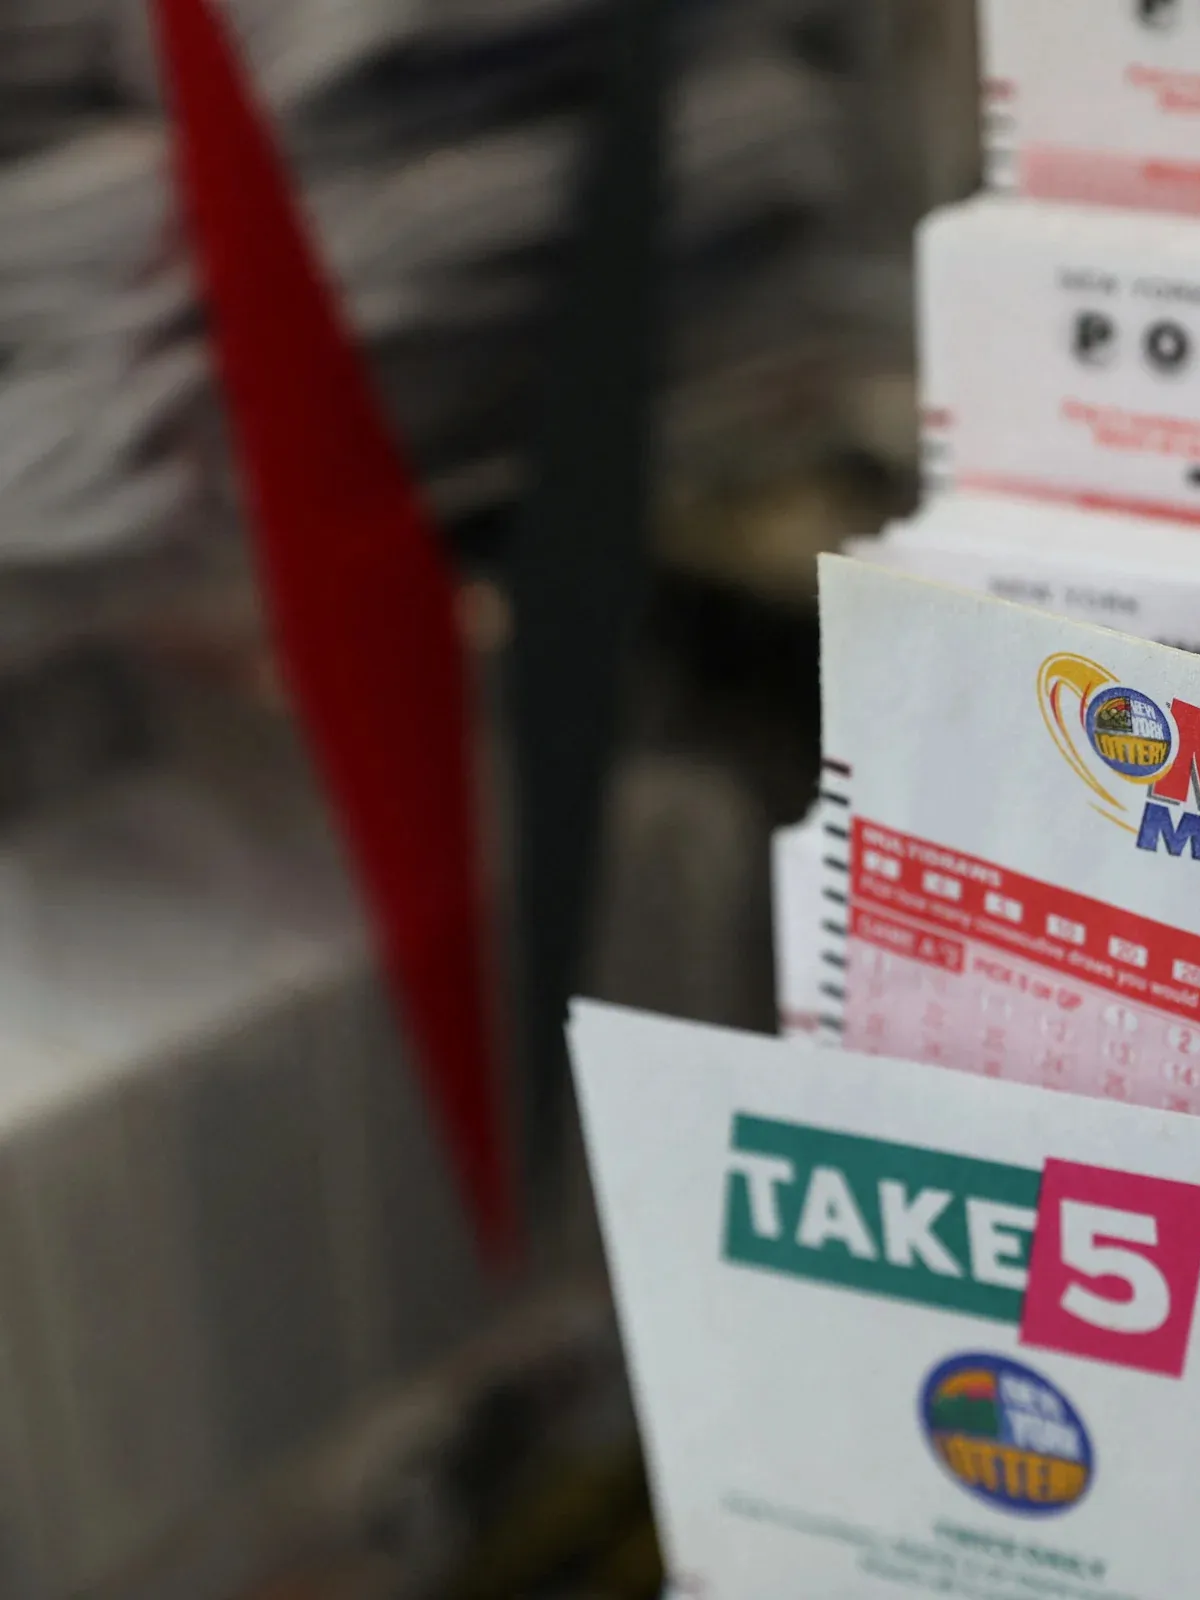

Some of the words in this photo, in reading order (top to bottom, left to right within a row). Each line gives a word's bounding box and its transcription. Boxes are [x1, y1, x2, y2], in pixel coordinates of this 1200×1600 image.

[1130, 699, 1157, 720] NEW
[1132, 716, 1165, 741] YORK
[1094, 732, 1168, 766] LOTTERY
[1067, 950, 1115, 979] draws
[1117, 969, 1147, 993] you
[1150, 980, 1199, 1008] would
[1178, 1030, 1192, 1054] 2
[1172, 1062, 1193, 1086] 14
[729, 1150, 1040, 1292] TAKE
[1059, 1199, 1172, 1335] 5
[1006, 1409, 1080, 1459] YORK
[932, 1428, 1089, 1504] LOTTERY
